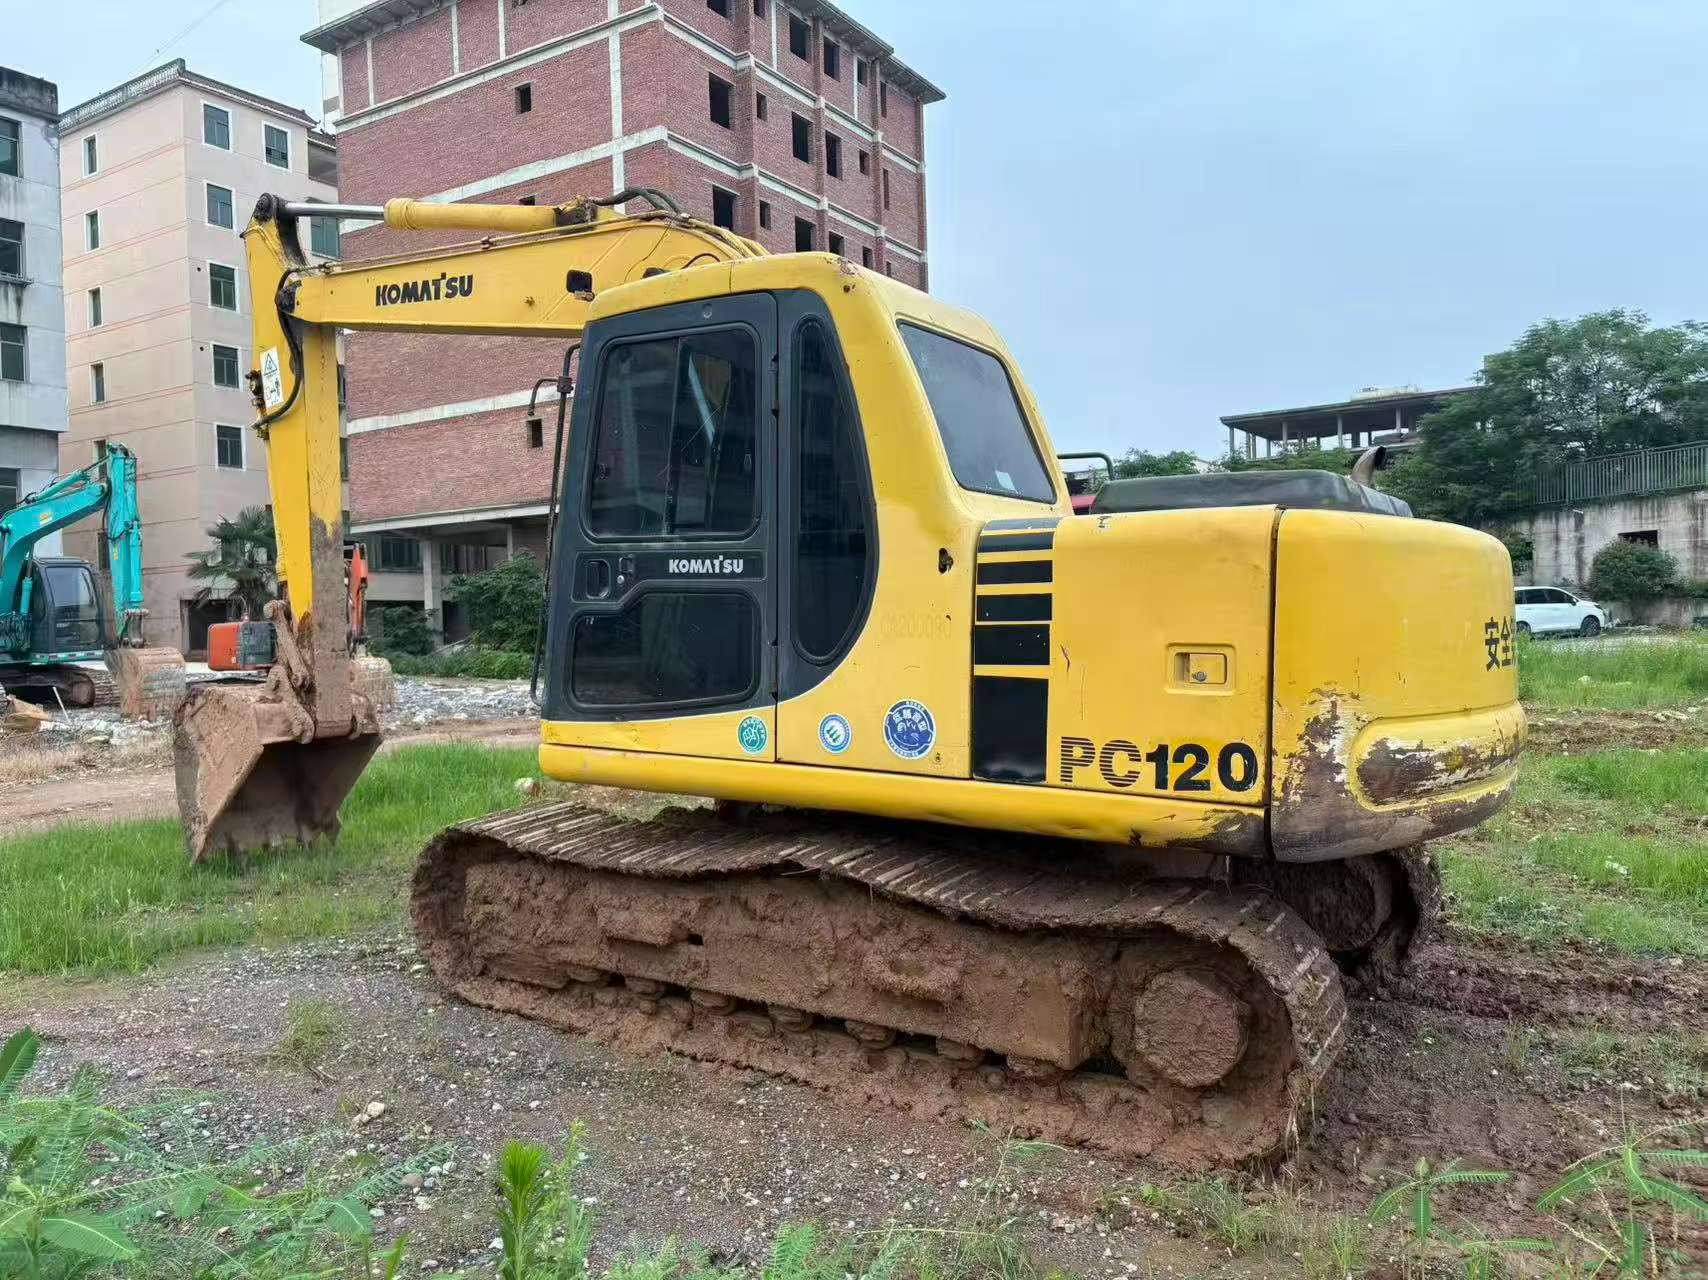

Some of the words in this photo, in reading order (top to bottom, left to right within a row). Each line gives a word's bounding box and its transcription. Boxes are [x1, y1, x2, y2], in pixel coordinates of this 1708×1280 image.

[376, 272, 473, 307] KOMATSU
[668, 555, 744, 574] KOMATSU
[1060, 736, 1259, 792] PC120
